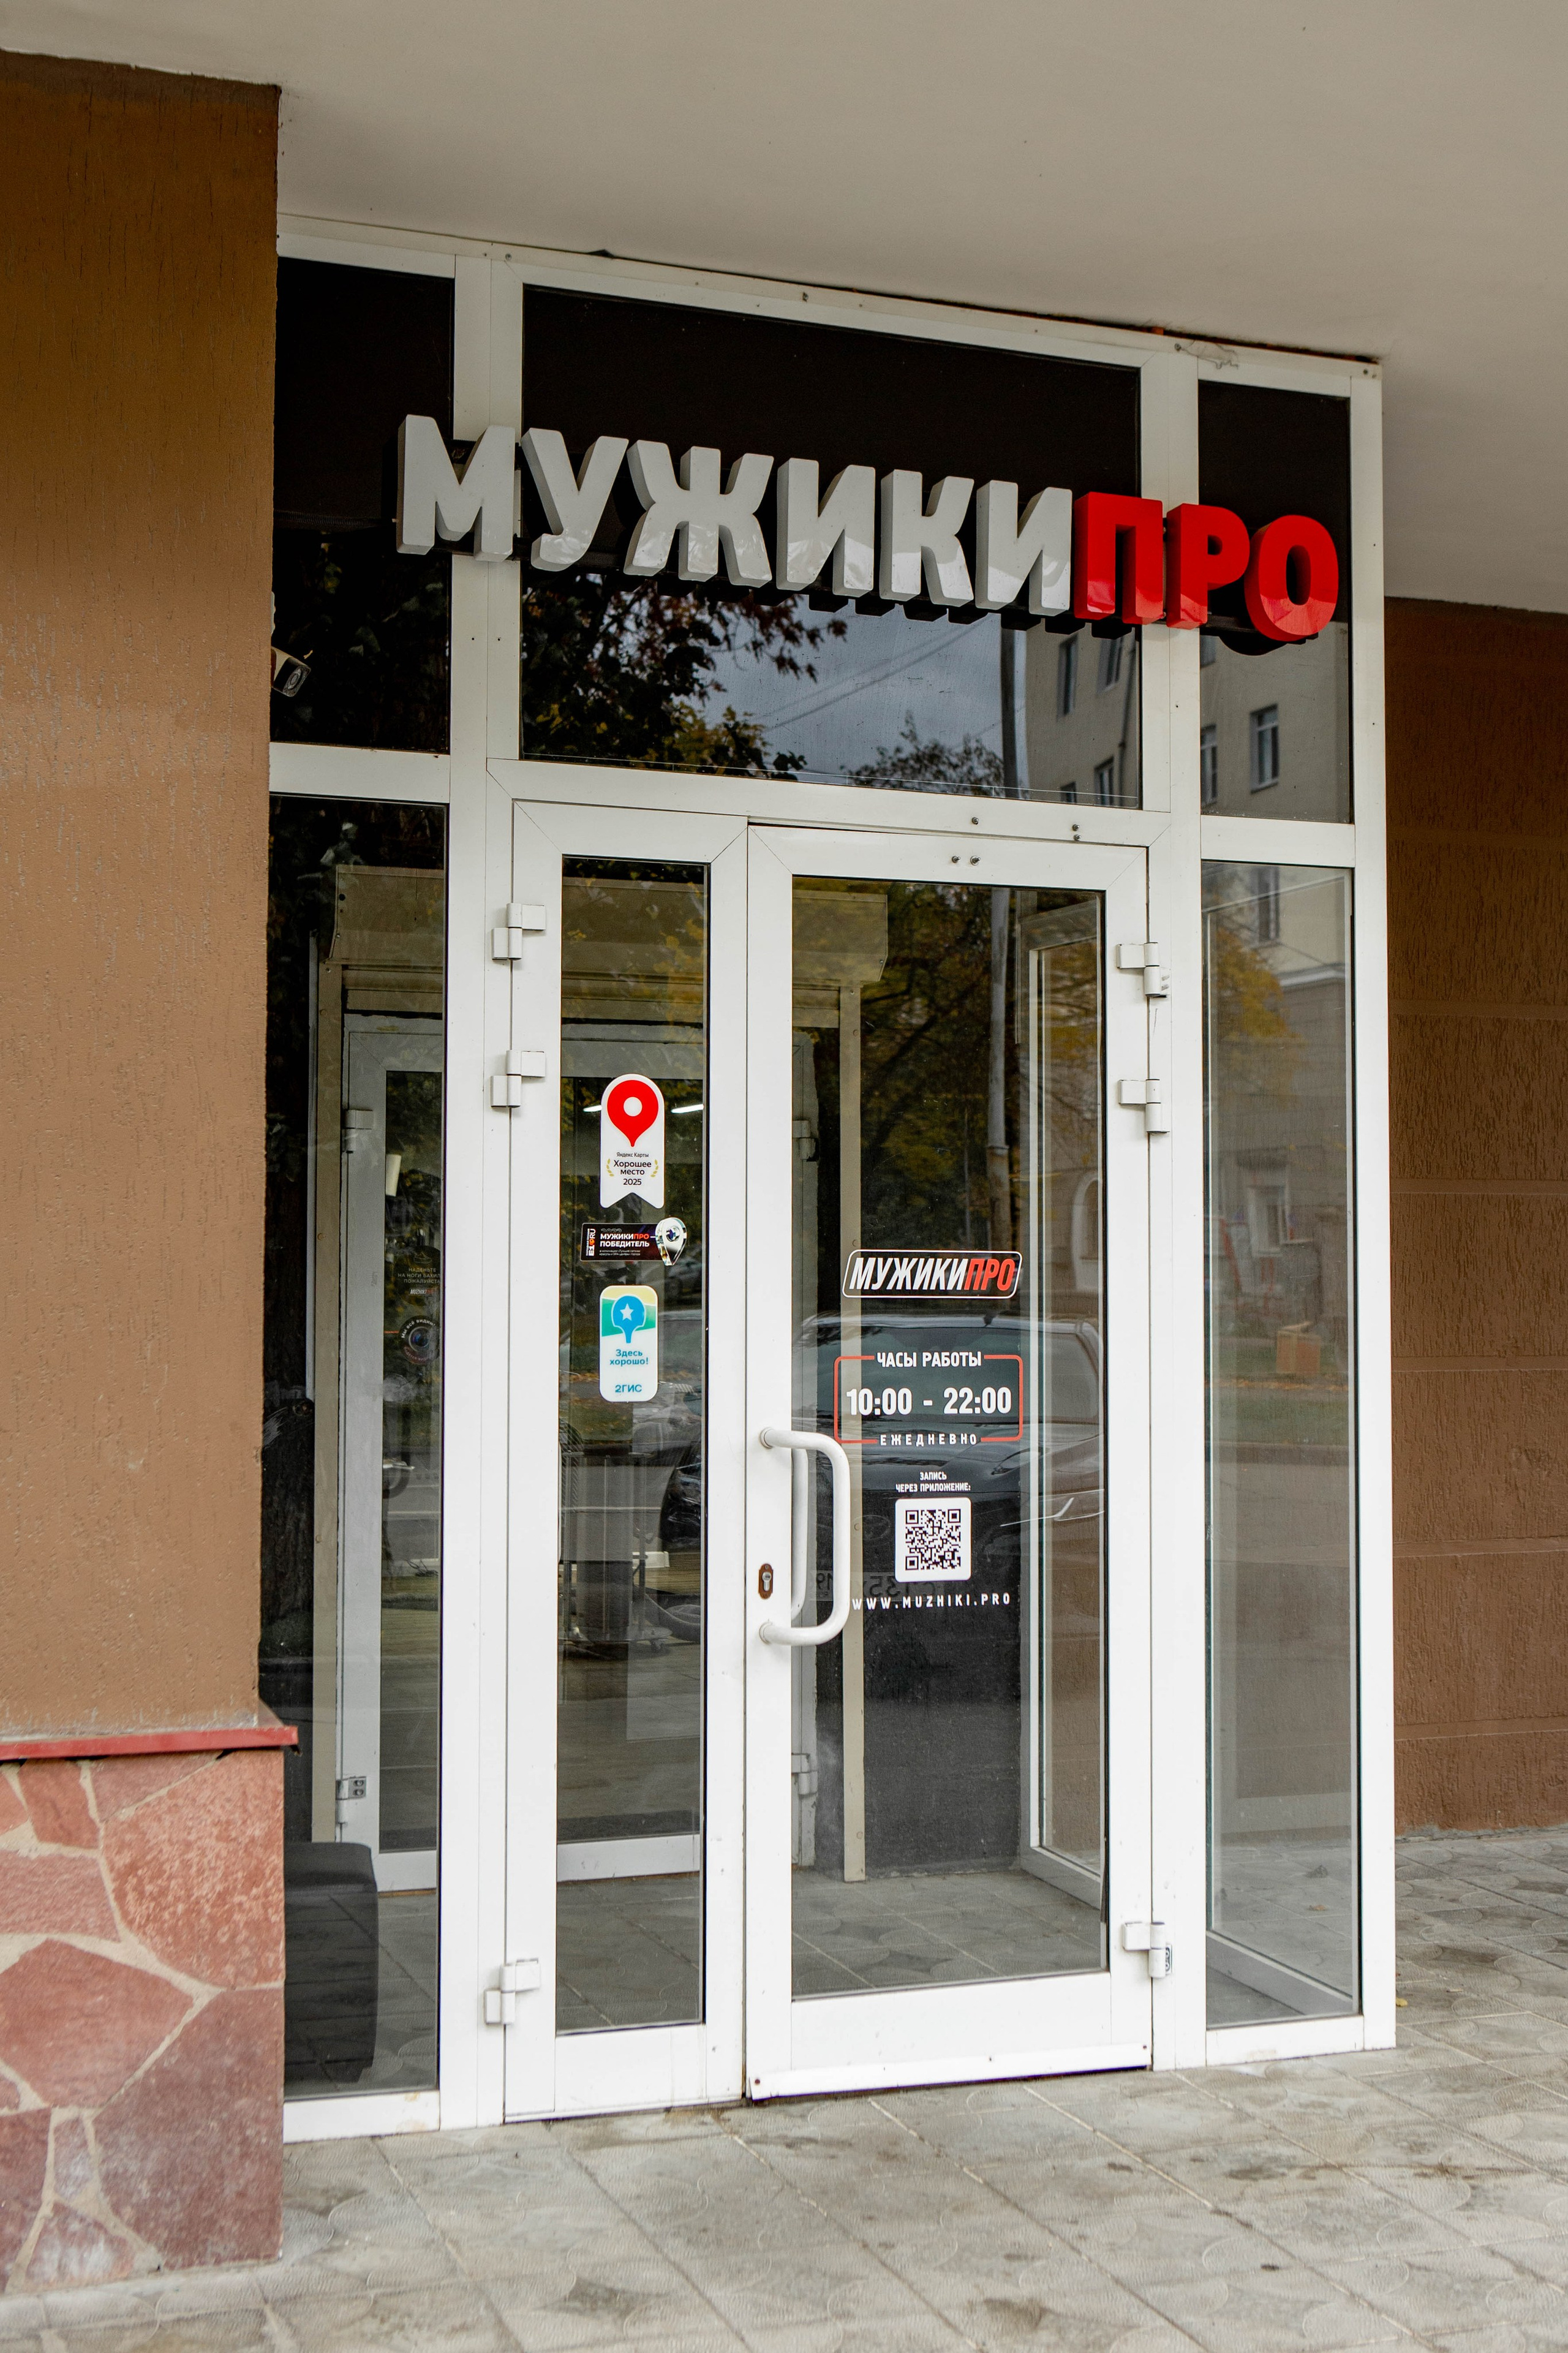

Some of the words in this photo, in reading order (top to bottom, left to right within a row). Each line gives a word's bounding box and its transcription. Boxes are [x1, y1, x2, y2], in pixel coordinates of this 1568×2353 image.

[396, 414, 1340, 643] МУЖИКИПРО
[613, 1160, 652, 1169] Хорошее
[849, 1256, 1016, 1291] МУЖИКИПРО
[609, 1357, 649, 1367] хорошо!
[877, 1352, 918, 1367] ЧАСЫ
[922, 1351, 981, 1367] РАБОТЫ
[615, 1384, 642, 1393] 2ГИС
[846, 1388, 912, 1415] 10:00
[944, 1387, 1011, 1414] 22:00
[880, 1433, 977, 1447] ЕЖЕДНЕВНО
[919, 1471, 947, 1481] ЗАПИСЬ
[895, 1483, 918, 1492] ЧЕРЕЗ
[920, 1482, 971, 1492] ПРИЛОЖЕНИЕ:
[852, 1593, 1009, 1610] WWW.MUZHIKI.PRO
